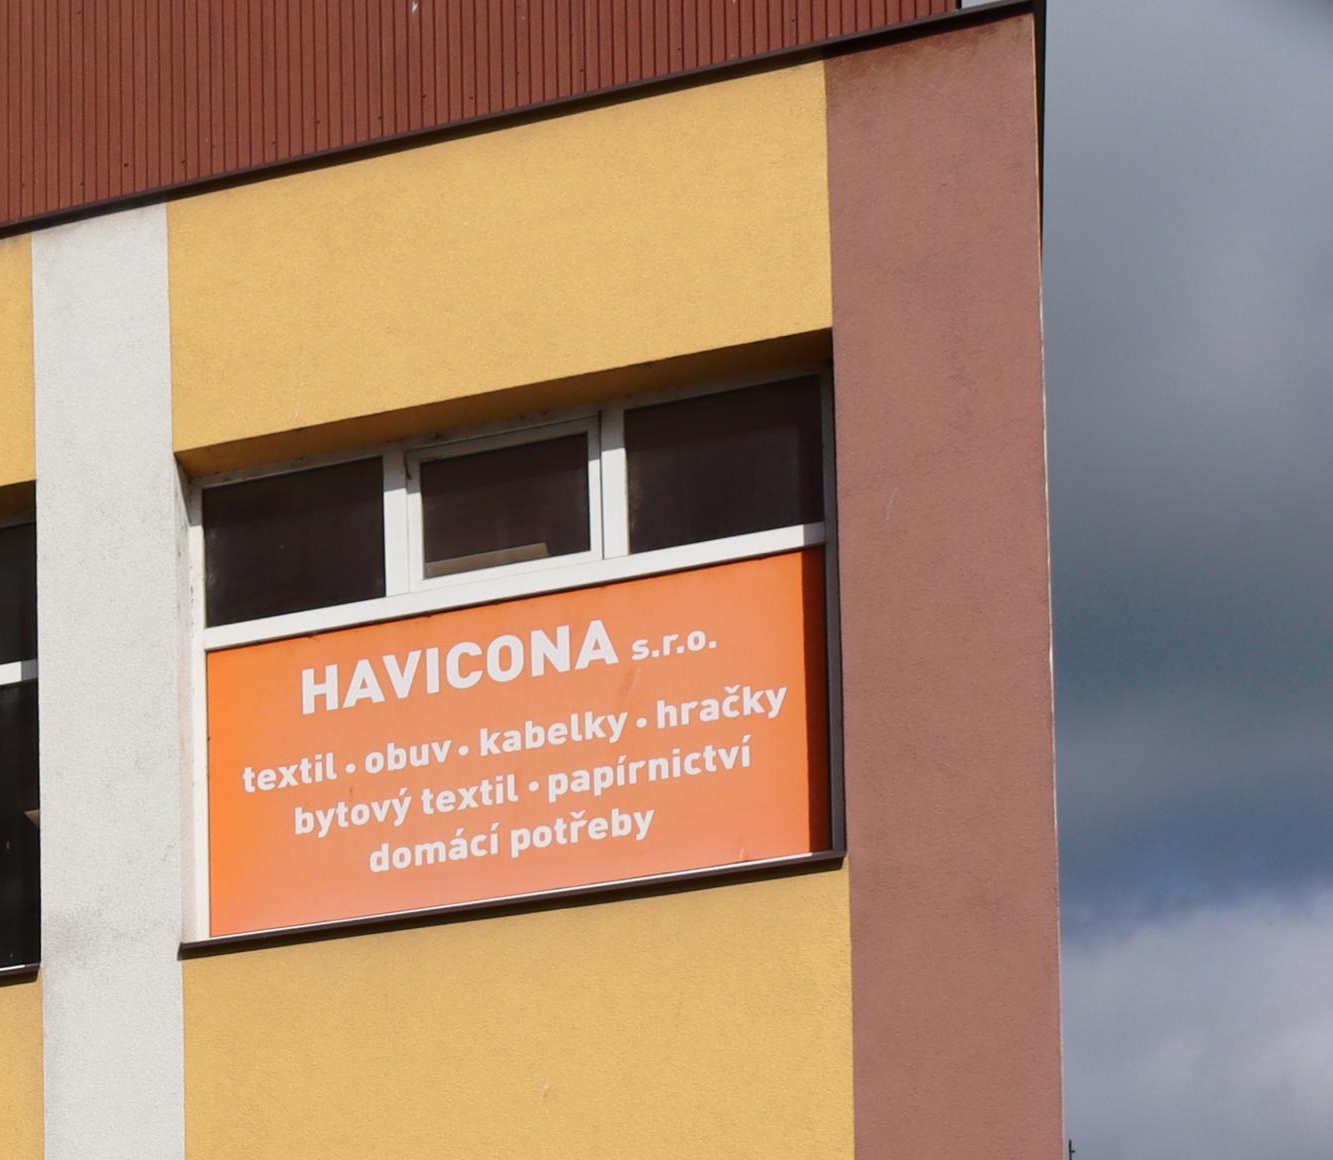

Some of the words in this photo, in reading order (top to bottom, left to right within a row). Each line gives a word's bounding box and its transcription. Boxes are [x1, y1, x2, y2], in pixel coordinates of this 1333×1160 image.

[301, 619, 619, 715] HAVICONA
[631, 628, 718, 662] s.r.o.
[243, 752, 336, 793] textil
[364, 737, 452, 775] obuv
[479, 709, 628, 757] kabelky
[657, 683, 788, 730] hračky
[294, 787, 412, 838] bytový
[421, 776, 518, 816] textil
[548, 734, 753, 802] papírnictví
[369, 822, 499, 872] domácí
[510, 807, 654, 859] potřeby
